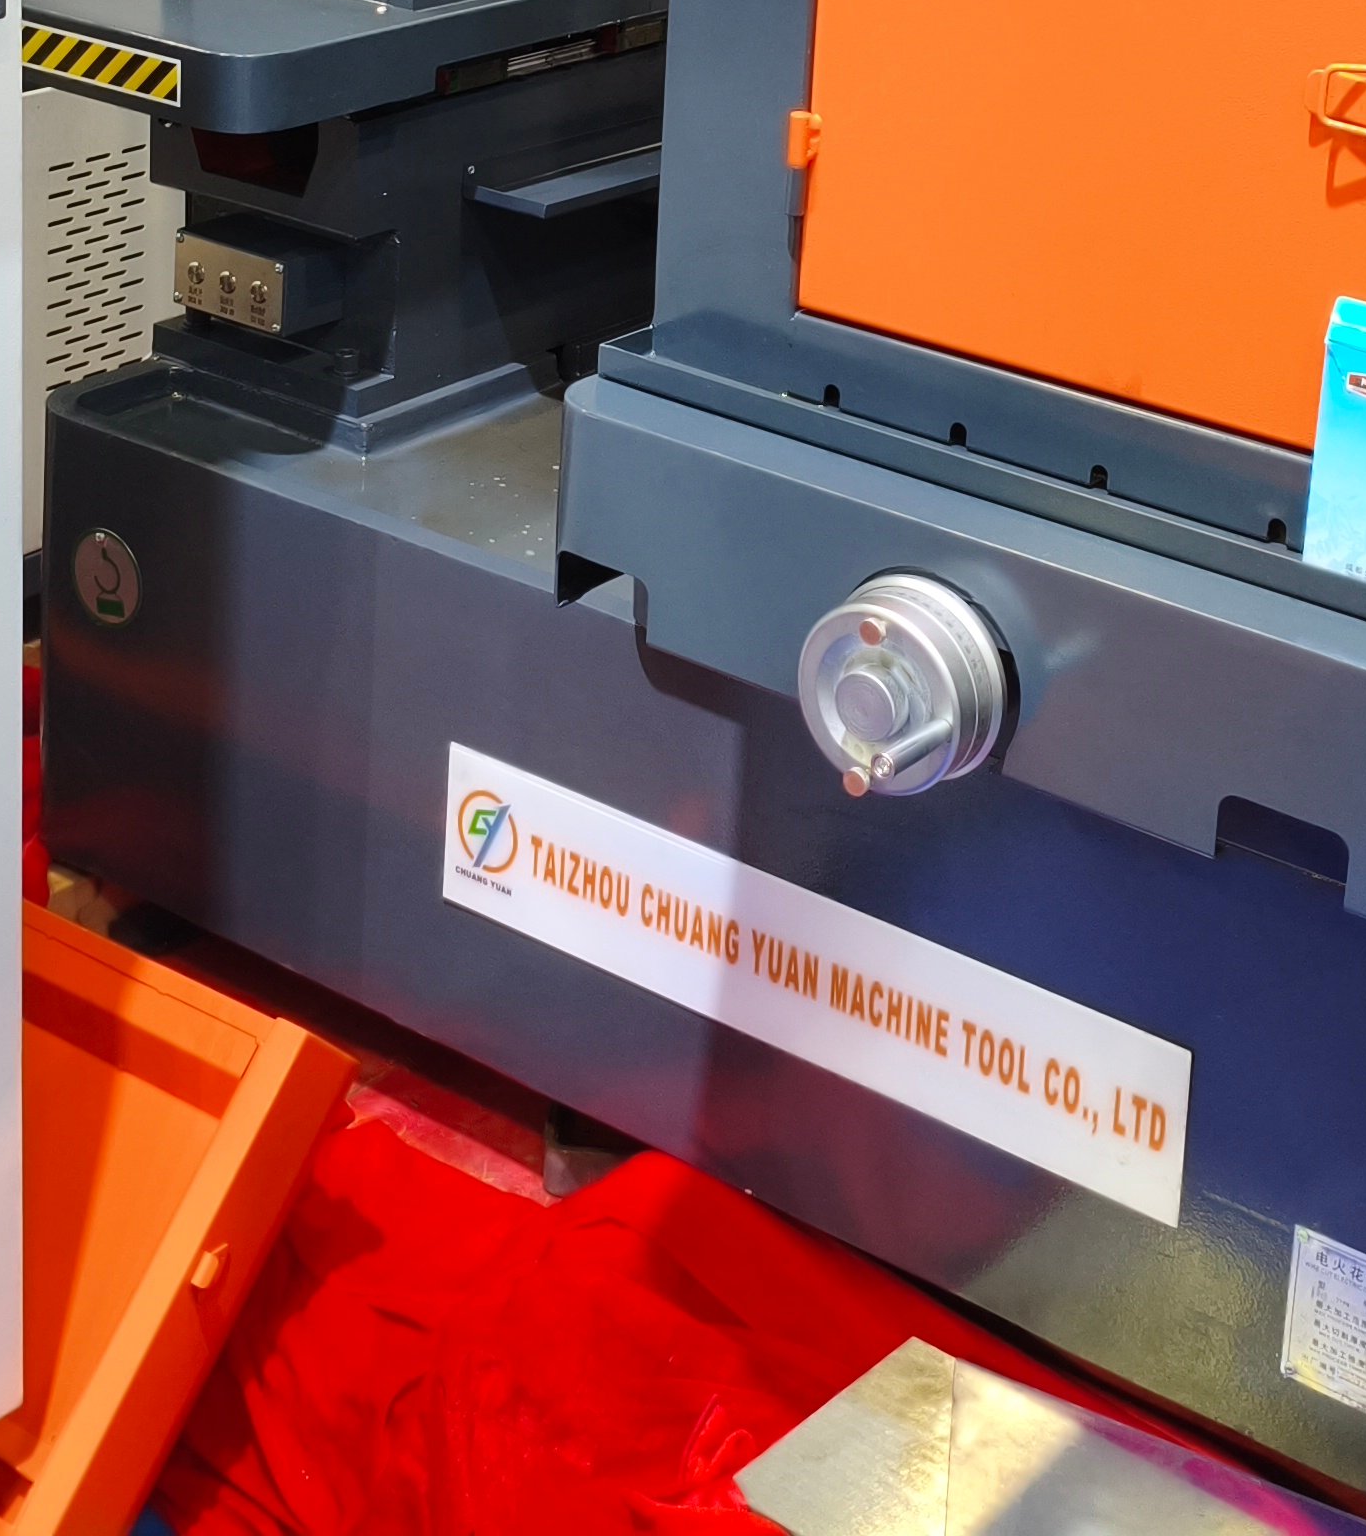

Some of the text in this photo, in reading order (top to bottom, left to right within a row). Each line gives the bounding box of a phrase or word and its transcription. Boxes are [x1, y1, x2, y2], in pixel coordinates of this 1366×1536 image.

[455, 865, 512, 896] CHUANG YUAN
[531, 834, 1167, 1152] TAIZHOU CHUANG YUAN MACHINE TOOL CO., LTD
